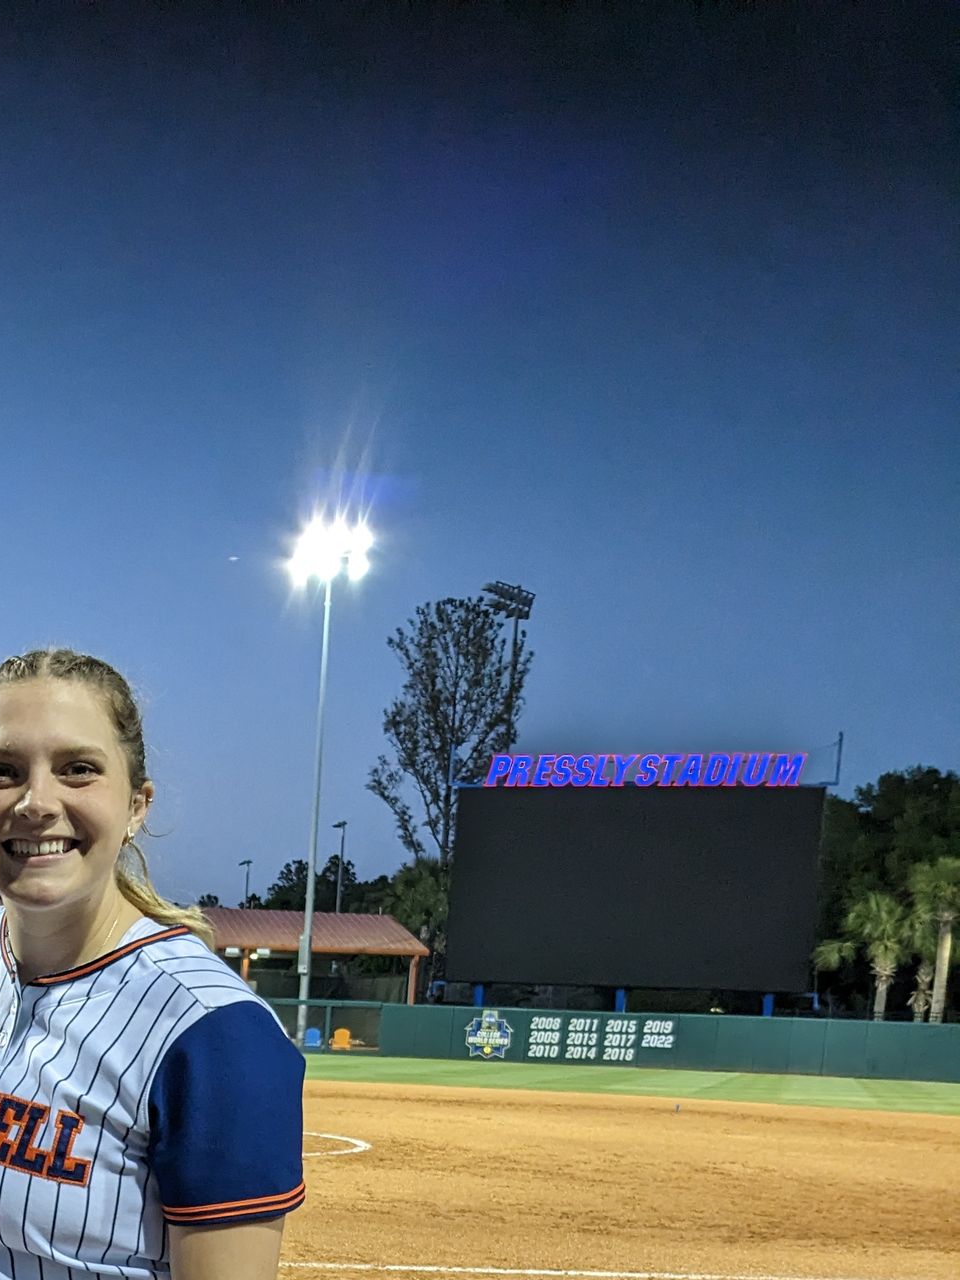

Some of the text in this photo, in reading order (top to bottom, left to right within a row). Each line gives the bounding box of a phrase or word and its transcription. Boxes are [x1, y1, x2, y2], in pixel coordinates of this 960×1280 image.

[483, 752, 808, 787] PRESSLY STADIUM
[530, 1016, 673, 1034] 2008 2011 2015 2019
[528, 1031, 674, 1048] 2009 2013 2017 2022
[527, 1045, 634, 1061] 2010 2014 2018
